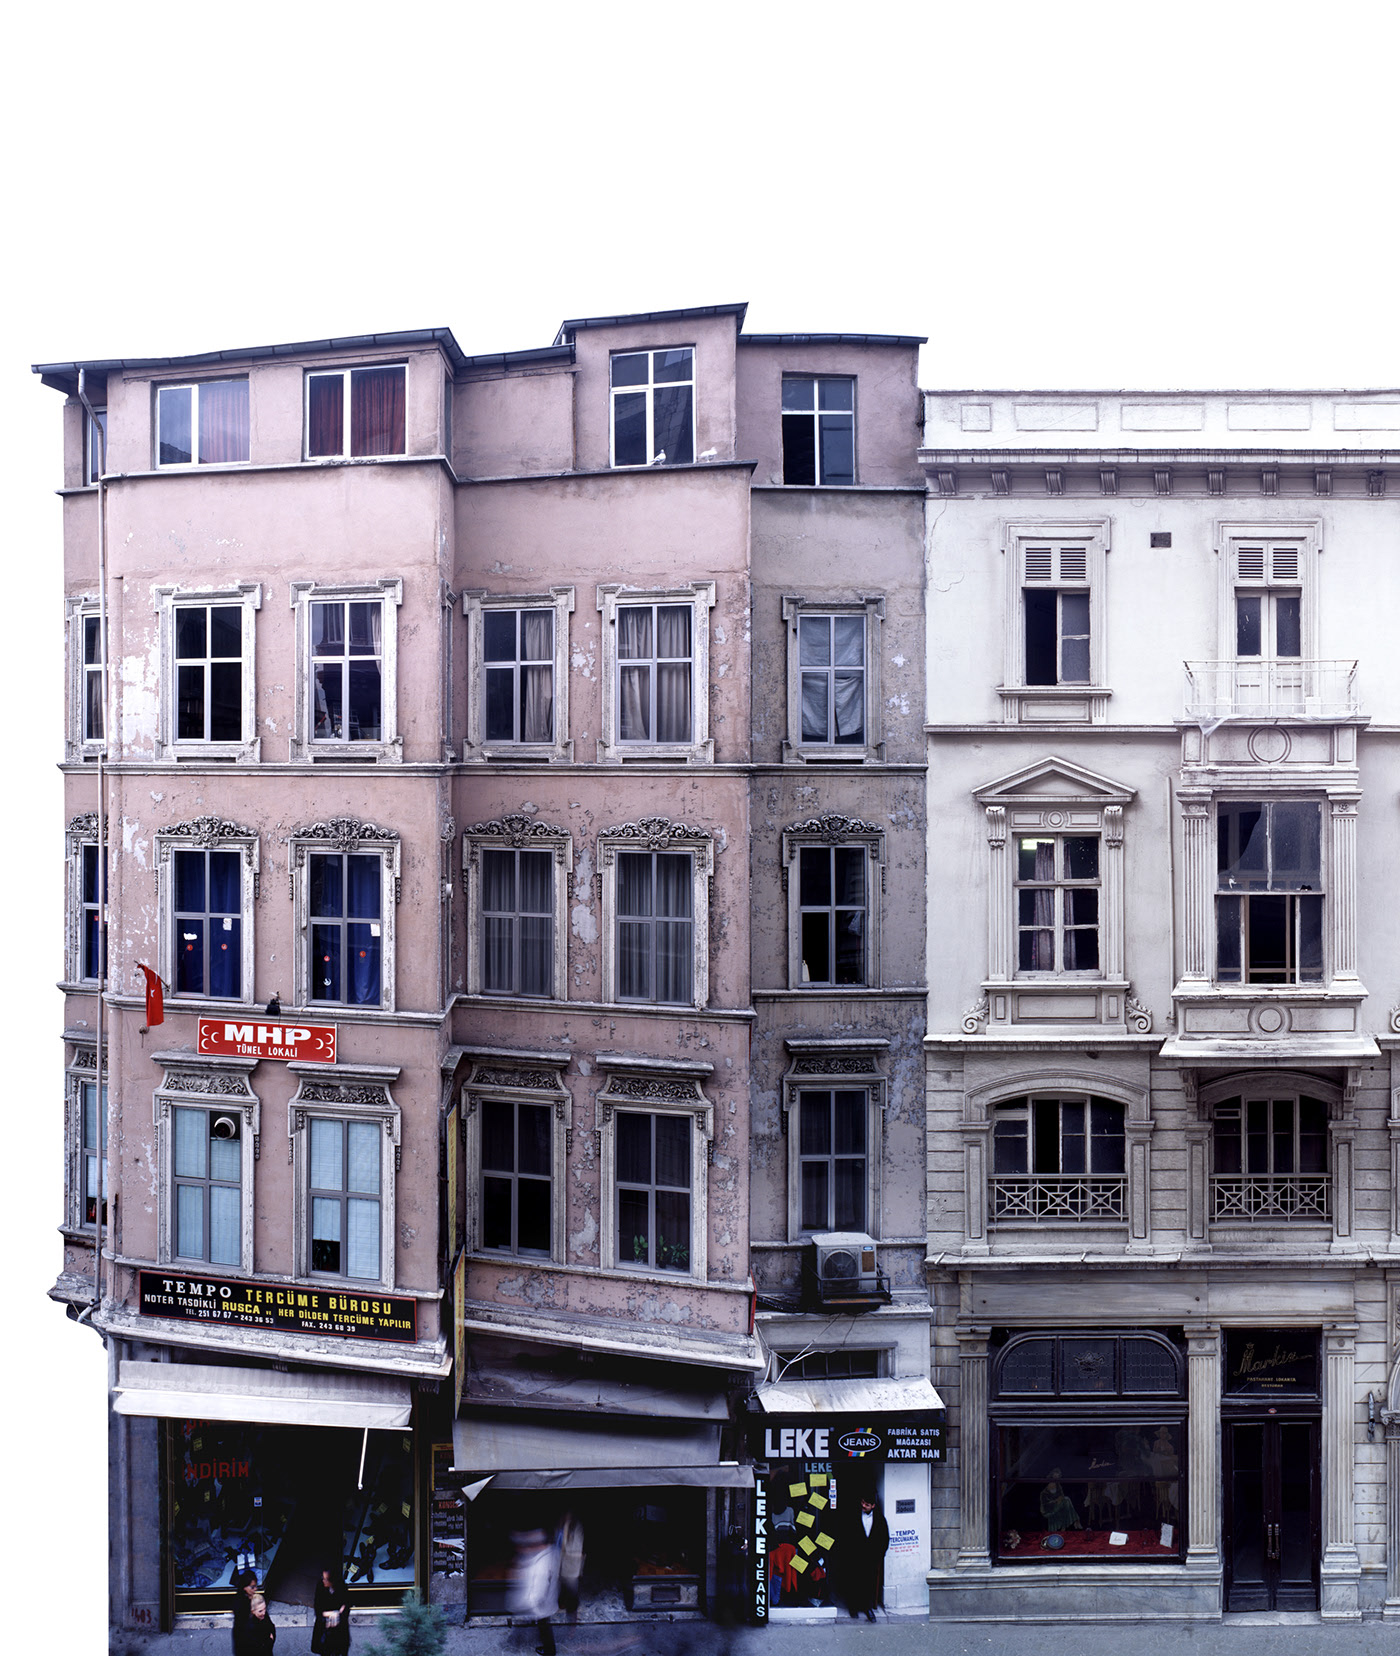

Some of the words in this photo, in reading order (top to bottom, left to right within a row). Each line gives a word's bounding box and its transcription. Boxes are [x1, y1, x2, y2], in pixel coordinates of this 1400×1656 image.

[224, 1024, 312, 1046] MHP
[236, 1044, 262, 1055] TÜNEL
[268, 1046, 298, 1058] LOKALİ
[162, 1279, 232, 1299] TEMPO
[245, 1288, 319, 1308] TERCÜME
[328, 1295, 392, 1315] BÜROSU
[144, 1294, 174, 1305] NOTER
[177, 1297, 217, 1309] TASDİKLİ
[278, 1308, 295, 1318] HER
[298, 1310, 329, 1321] DİLDEN
[333, 1313, 375, 1326] TERCÜME
[378, 1318, 411, 1329] YAPILIR
[185, 1308, 197, 1316] TEL.
[198, 1309, 210, 1318] 251
[301, 1320, 316, 1329] FAX.
[318, 1322, 333, 1330] 243
[346, 1325, 356, 1333] 39
[887, 1427, 917, 1436] FABRİKA
[920, 1429, 940, 1437] SATIŞ
[764, 1428, 830, 1458] LEKE
[843, 1438, 876, 1447] JEANS
[896, 1437, 931, 1447] MAĞAZASI
[887, 1449, 917, 1459] AKTAR
[921, 1449, 940, 1459] HAN
[805, 1463, 832, 1473] LEKE
[755, 1480, 768, 1555] LEKE
[756, 1558, 766, 1618] JEANS
